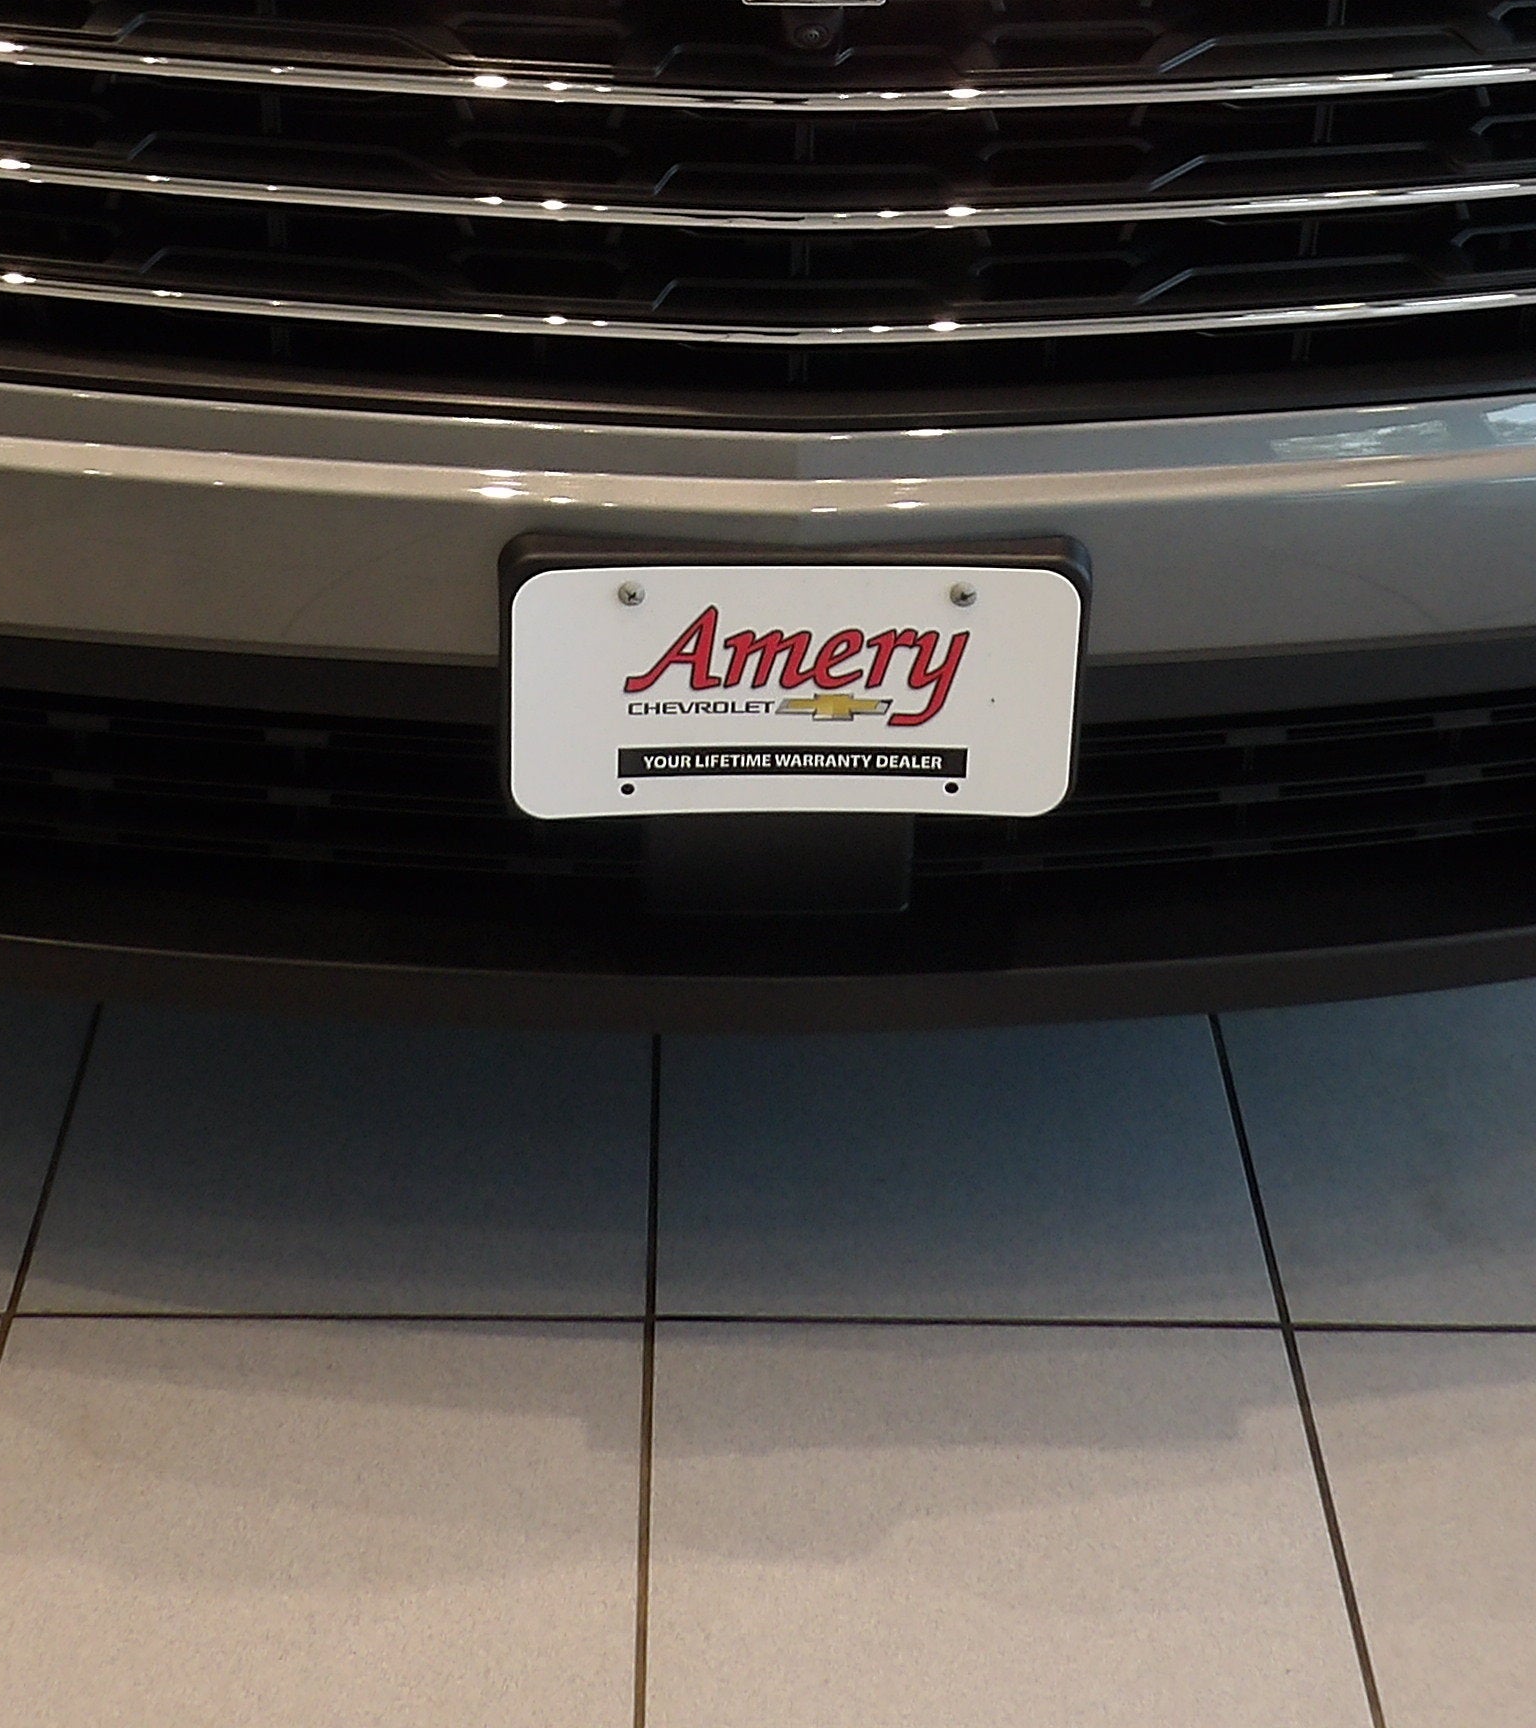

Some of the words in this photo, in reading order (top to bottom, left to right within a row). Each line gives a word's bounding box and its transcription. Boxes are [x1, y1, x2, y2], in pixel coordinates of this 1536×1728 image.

[623, 605, 970, 727] Amery
[627, 700, 775, 716] CHEVROLET
[643, 754, 692, 770] YOUR
[695, 753, 772, 768] LIFETIME
[774, 753, 872, 769] WARRANTY
[875, 754, 943, 770] DEALER
